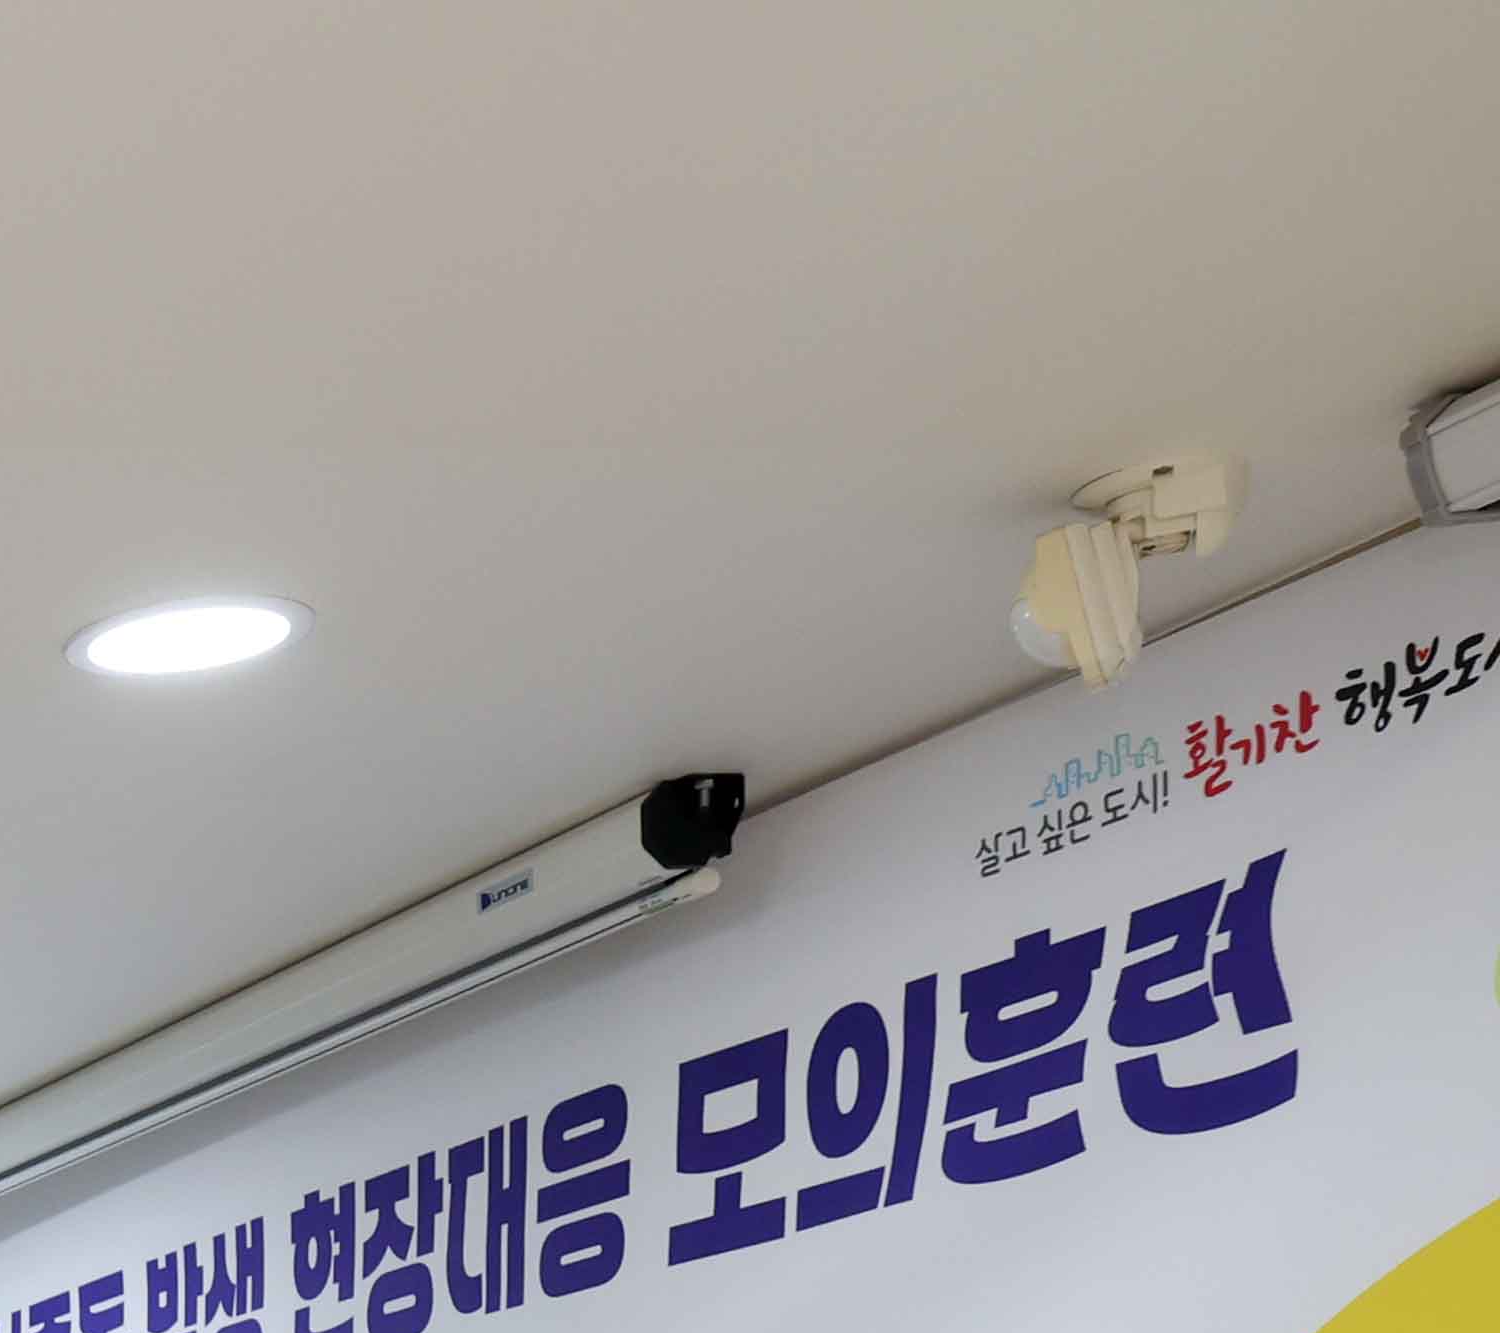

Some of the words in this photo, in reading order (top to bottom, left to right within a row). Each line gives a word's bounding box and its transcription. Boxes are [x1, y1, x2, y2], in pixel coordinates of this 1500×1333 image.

[1183, 690, 1320, 797] 활기찬
[975, 827, 1030, 877] 살고
[1037, 800, 1093, 857] 싶은
[1101, 771, 1169, 827] 도시!
[667, 847, 1298, 1267] 모의훈련
